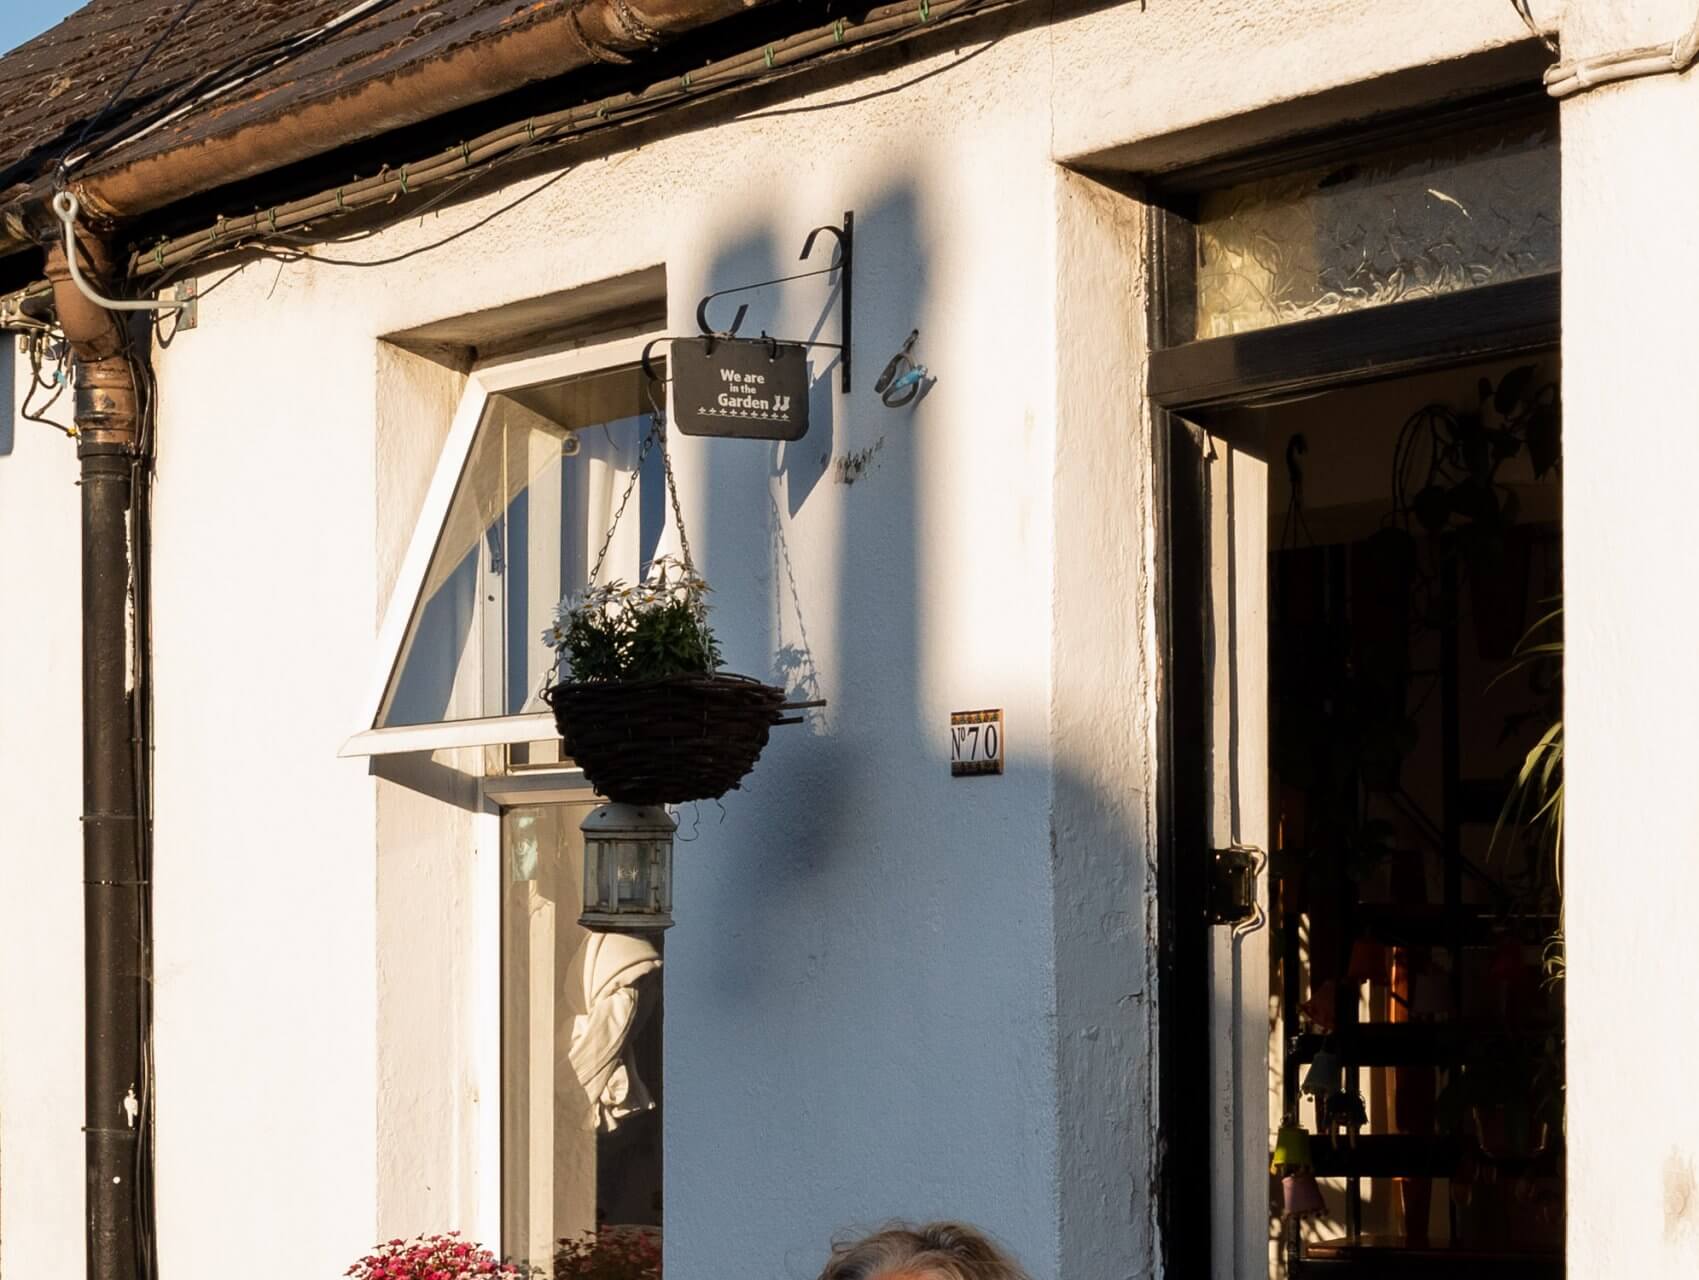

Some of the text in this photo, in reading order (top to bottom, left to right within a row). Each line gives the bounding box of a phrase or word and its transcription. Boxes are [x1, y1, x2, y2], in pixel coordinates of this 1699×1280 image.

[720, 368, 765, 384] We are
[729, 383, 757, 394] in the
[717, 393, 769, 410] Garden
